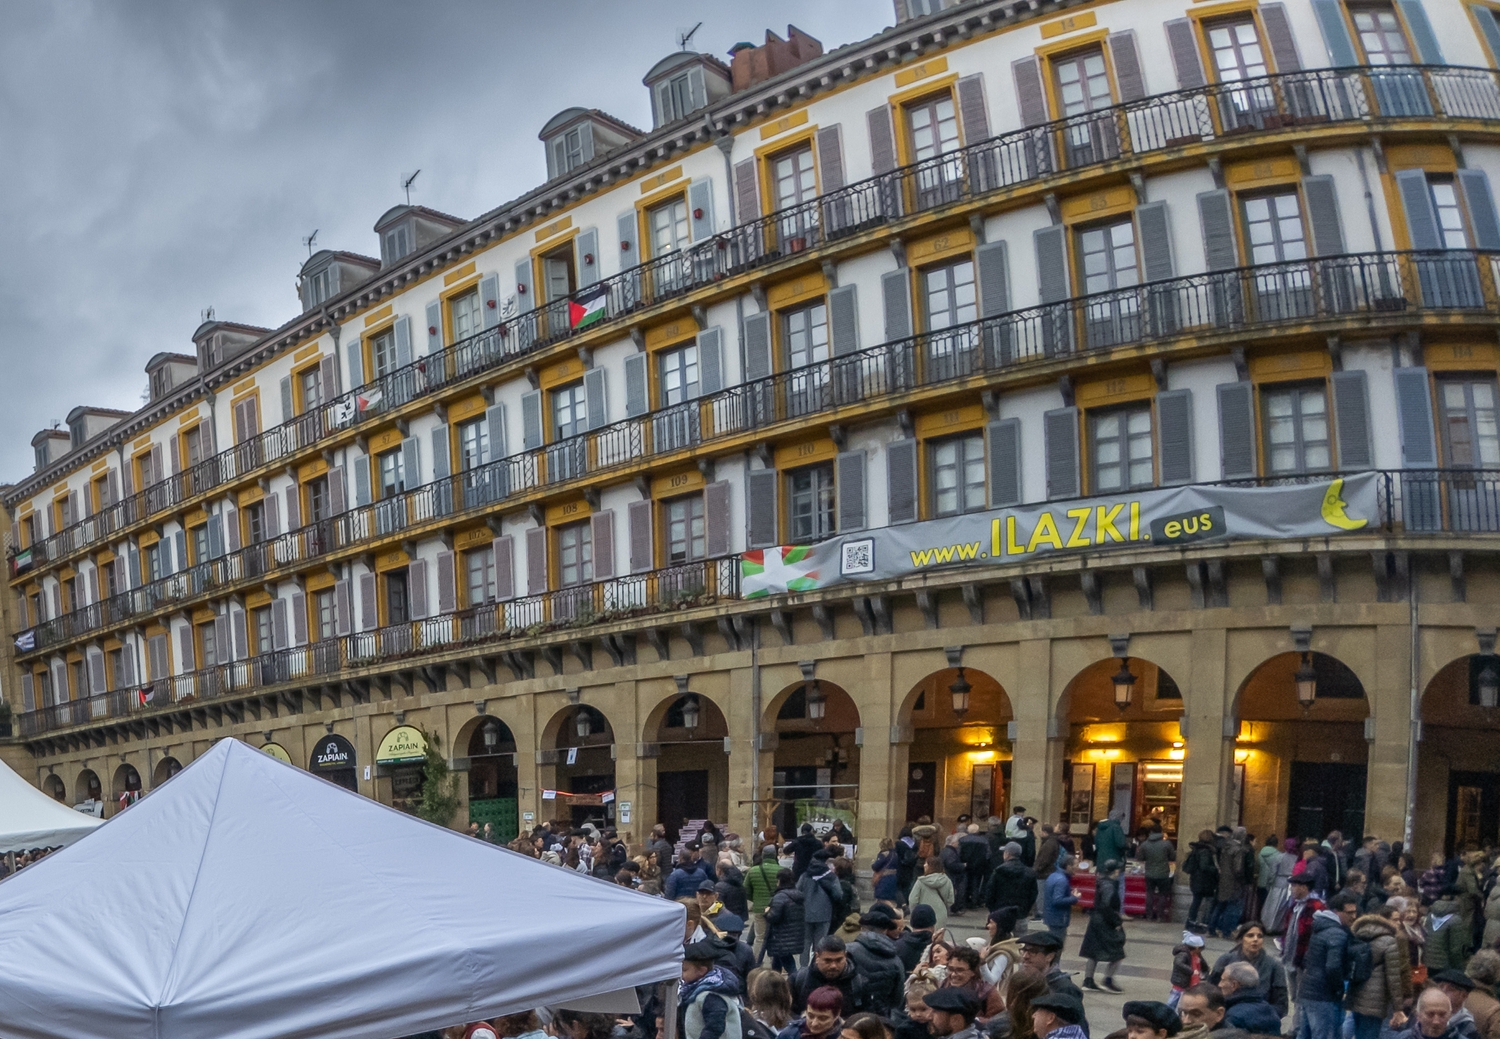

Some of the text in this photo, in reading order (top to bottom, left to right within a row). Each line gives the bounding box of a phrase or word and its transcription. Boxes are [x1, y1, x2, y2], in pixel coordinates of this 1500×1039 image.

[933, 237, 949, 251] 62
[382, 433, 391, 444] 57
[798, 443, 815, 457] 110
[670, 475, 689, 488] 109
[562, 504, 578, 516] 108
[388, 742, 419, 752] ZAPIAIN
[318, 752, 348, 764] ZAPIAIN
